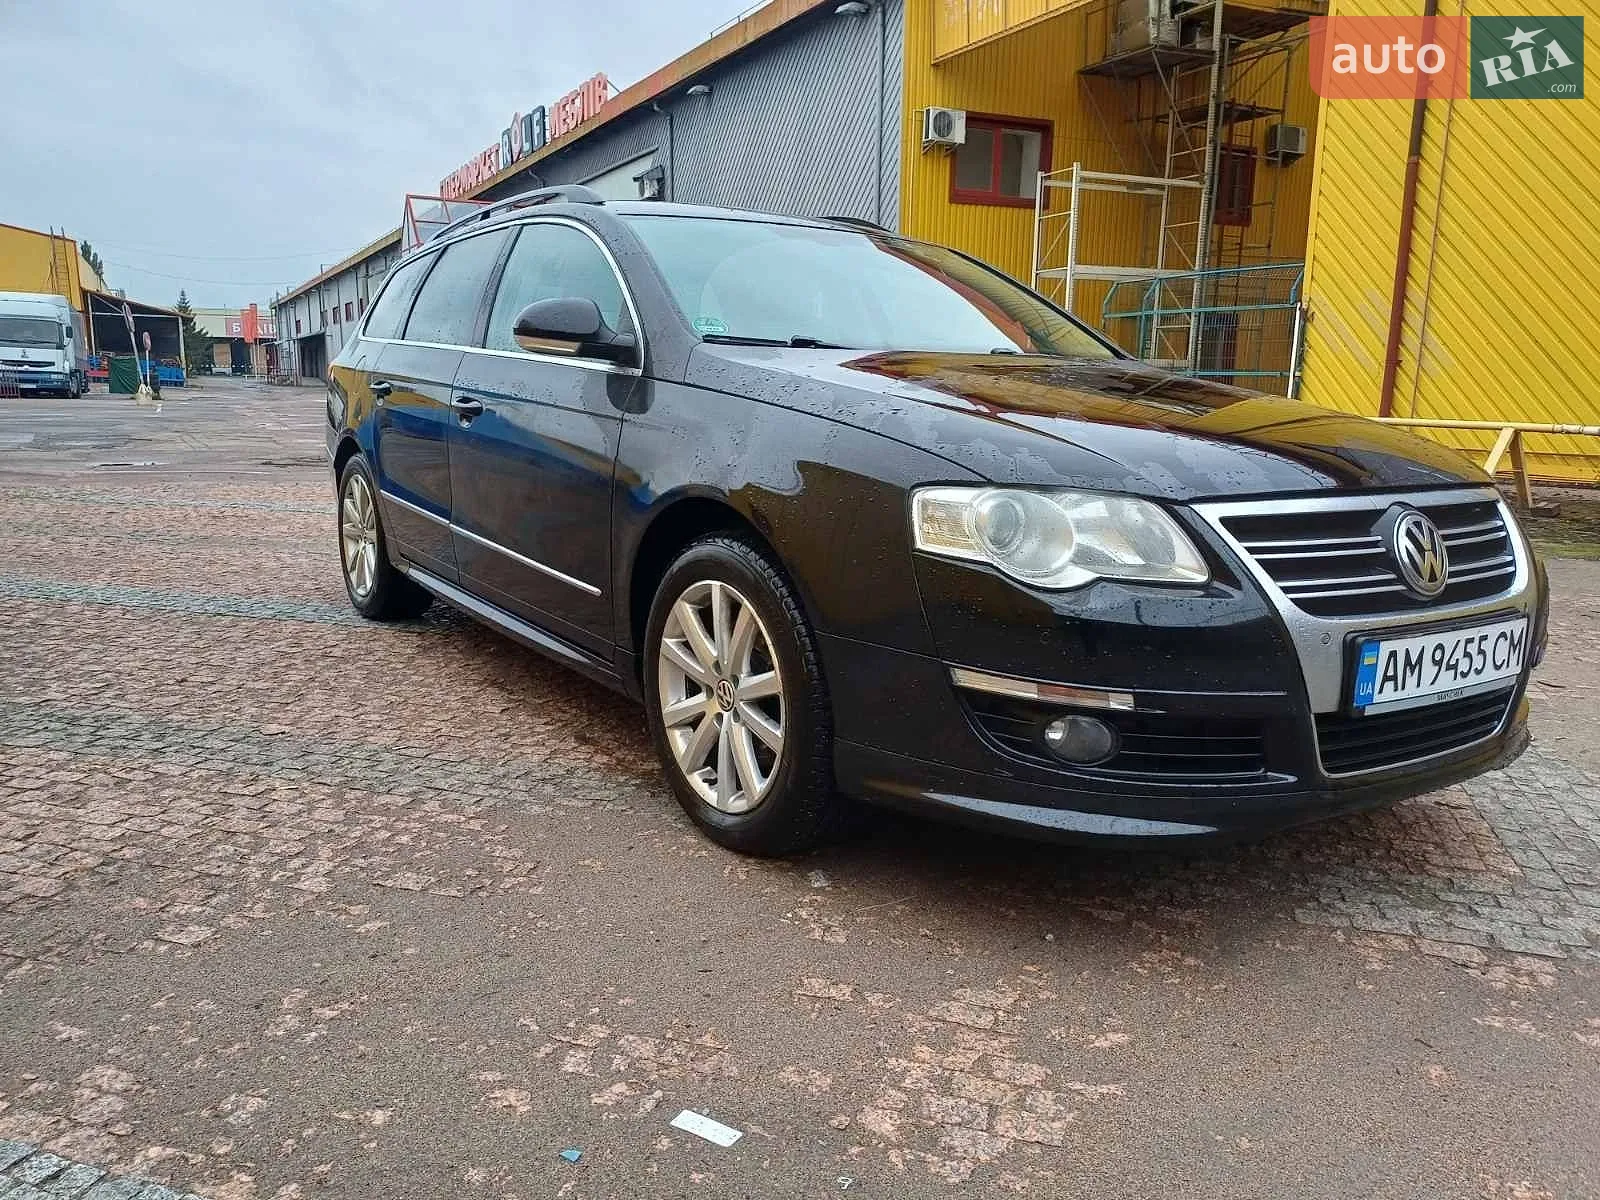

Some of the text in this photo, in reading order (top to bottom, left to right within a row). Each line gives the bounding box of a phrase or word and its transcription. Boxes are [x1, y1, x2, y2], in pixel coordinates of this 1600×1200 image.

[1377, 627, 1525, 695] AM 9455 CM
[1359, 682, 1373, 696] UA
